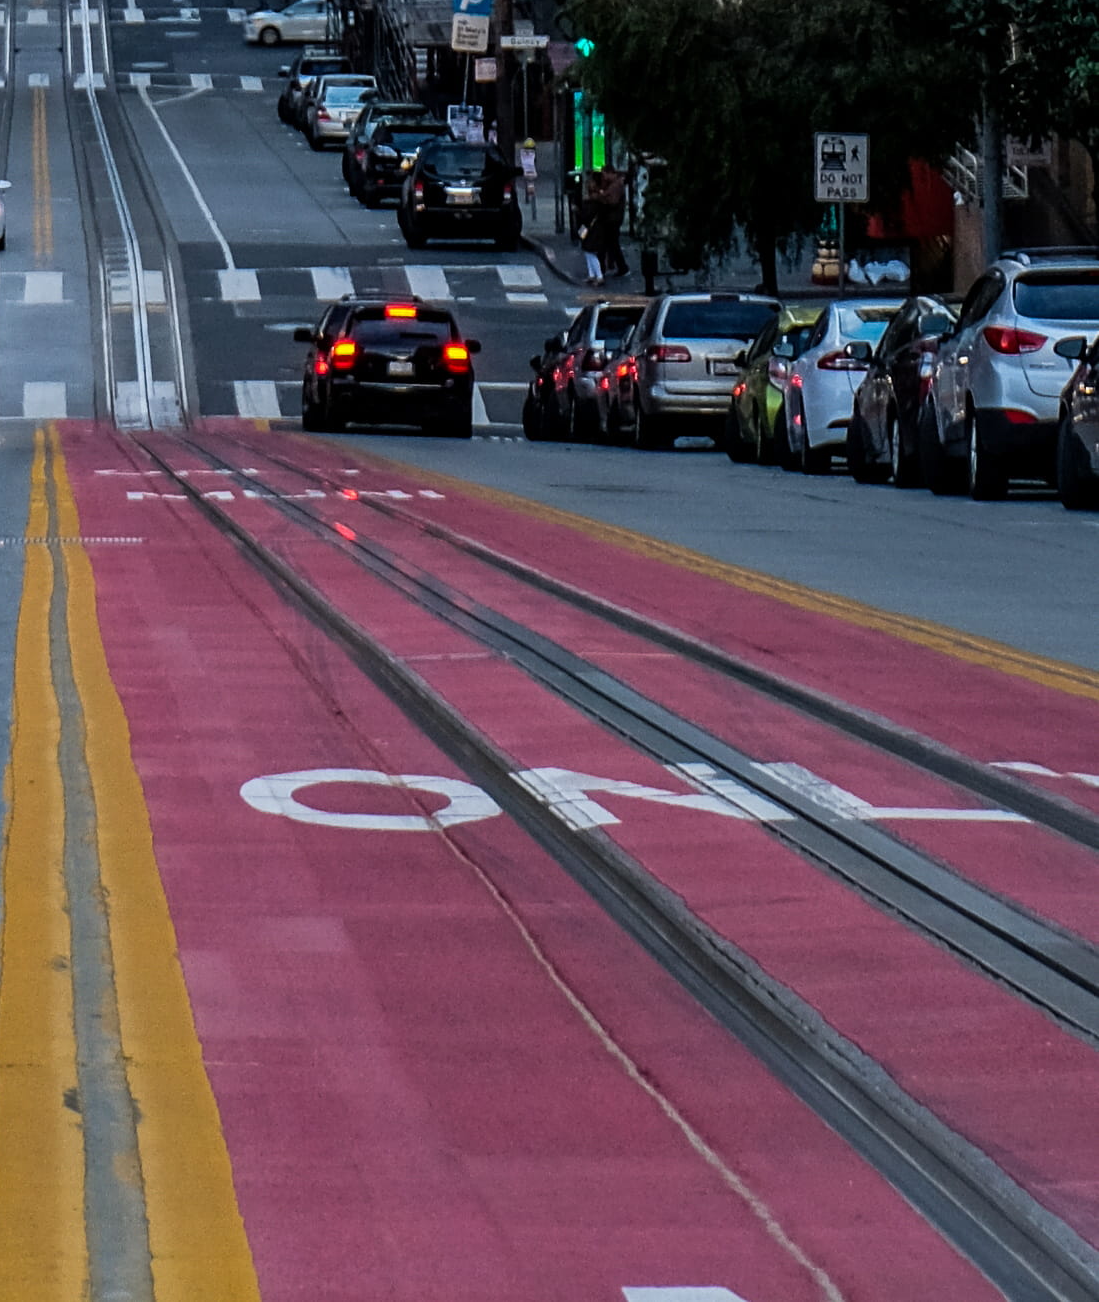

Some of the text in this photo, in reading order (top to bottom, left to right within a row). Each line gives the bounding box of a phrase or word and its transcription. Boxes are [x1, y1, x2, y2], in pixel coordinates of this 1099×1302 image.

[820, 172, 863, 184] DO NOT
[827, 187, 857, 198] PASS
